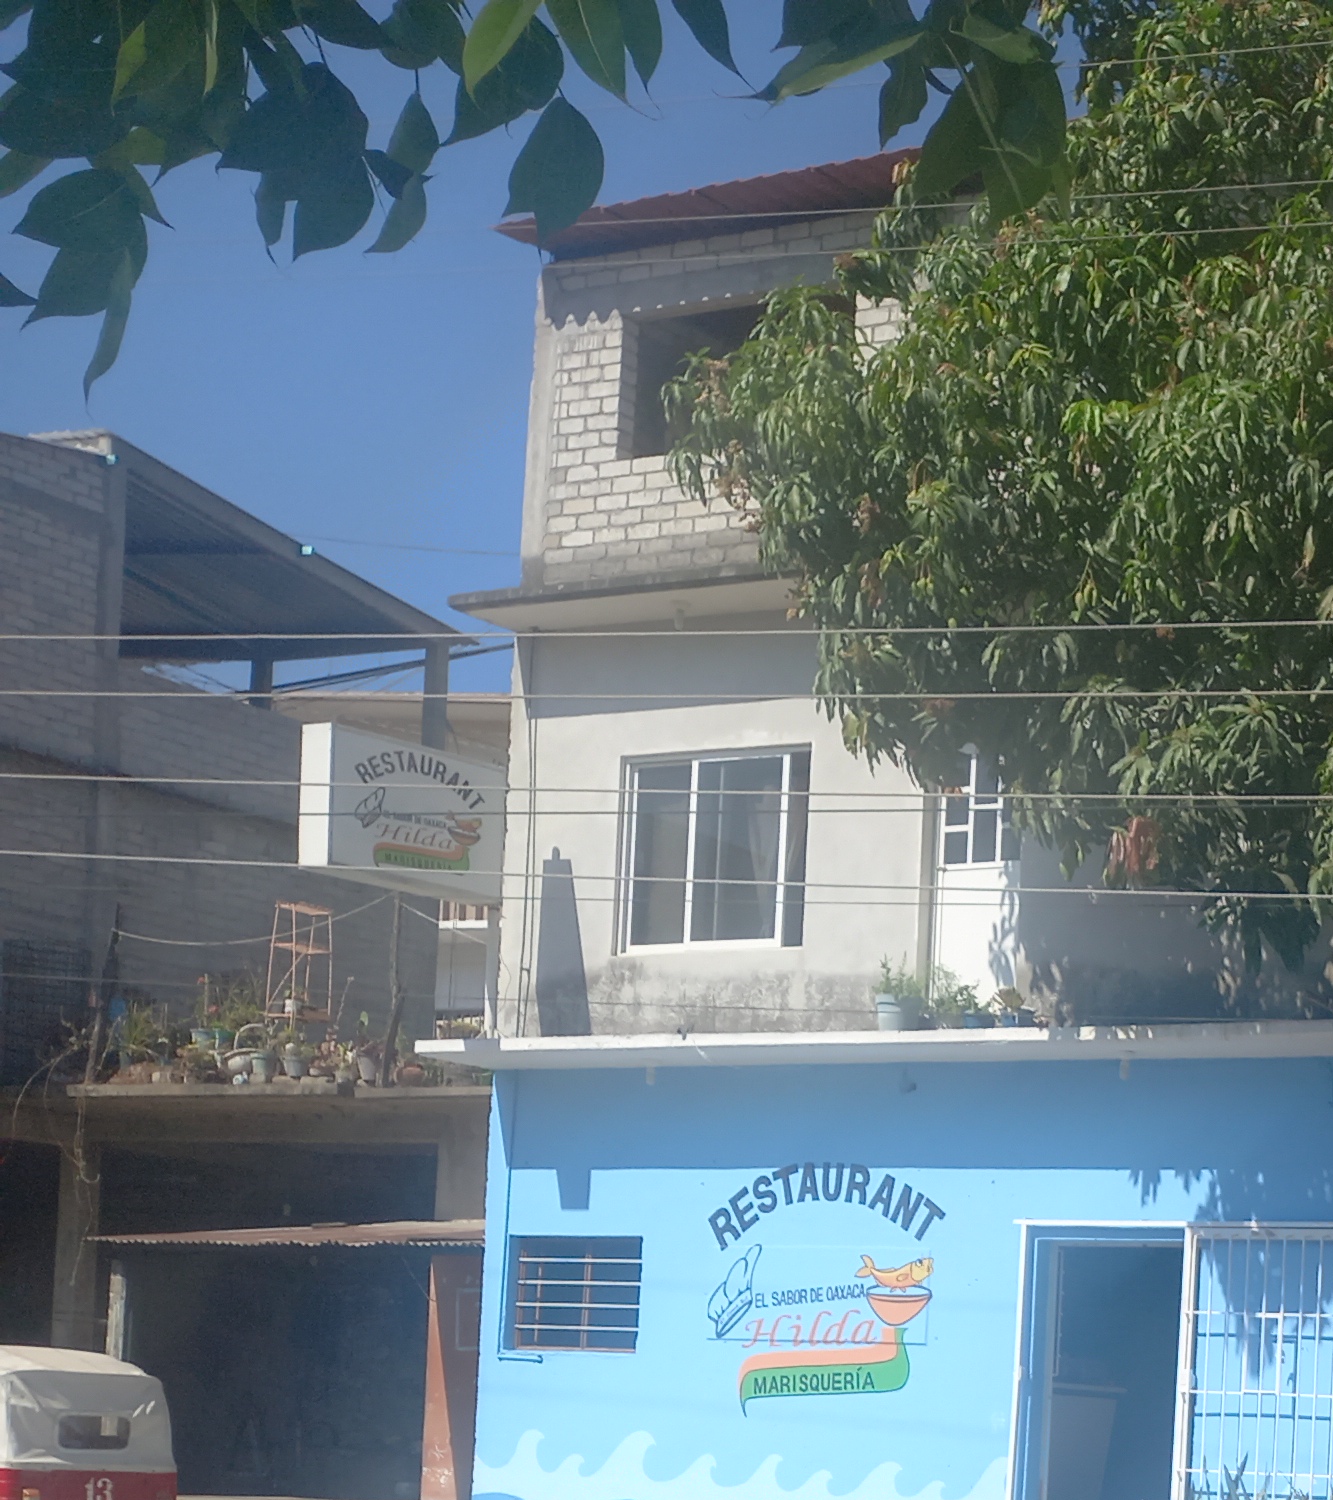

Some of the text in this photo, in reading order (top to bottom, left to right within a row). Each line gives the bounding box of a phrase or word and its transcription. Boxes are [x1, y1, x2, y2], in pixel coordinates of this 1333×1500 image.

[354, 750, 485, 810] RESTAURANT
[374, 824, 453, 850] Hilda
[707, 1161, 947, 1251] RESTAURANT
[754, 1283, 867, 1308] EL SABOR DE OAXACA
[741, 1309, 878, 1348] Hilda
[753, 1366, 875, 1395] MARISQUERÍA
